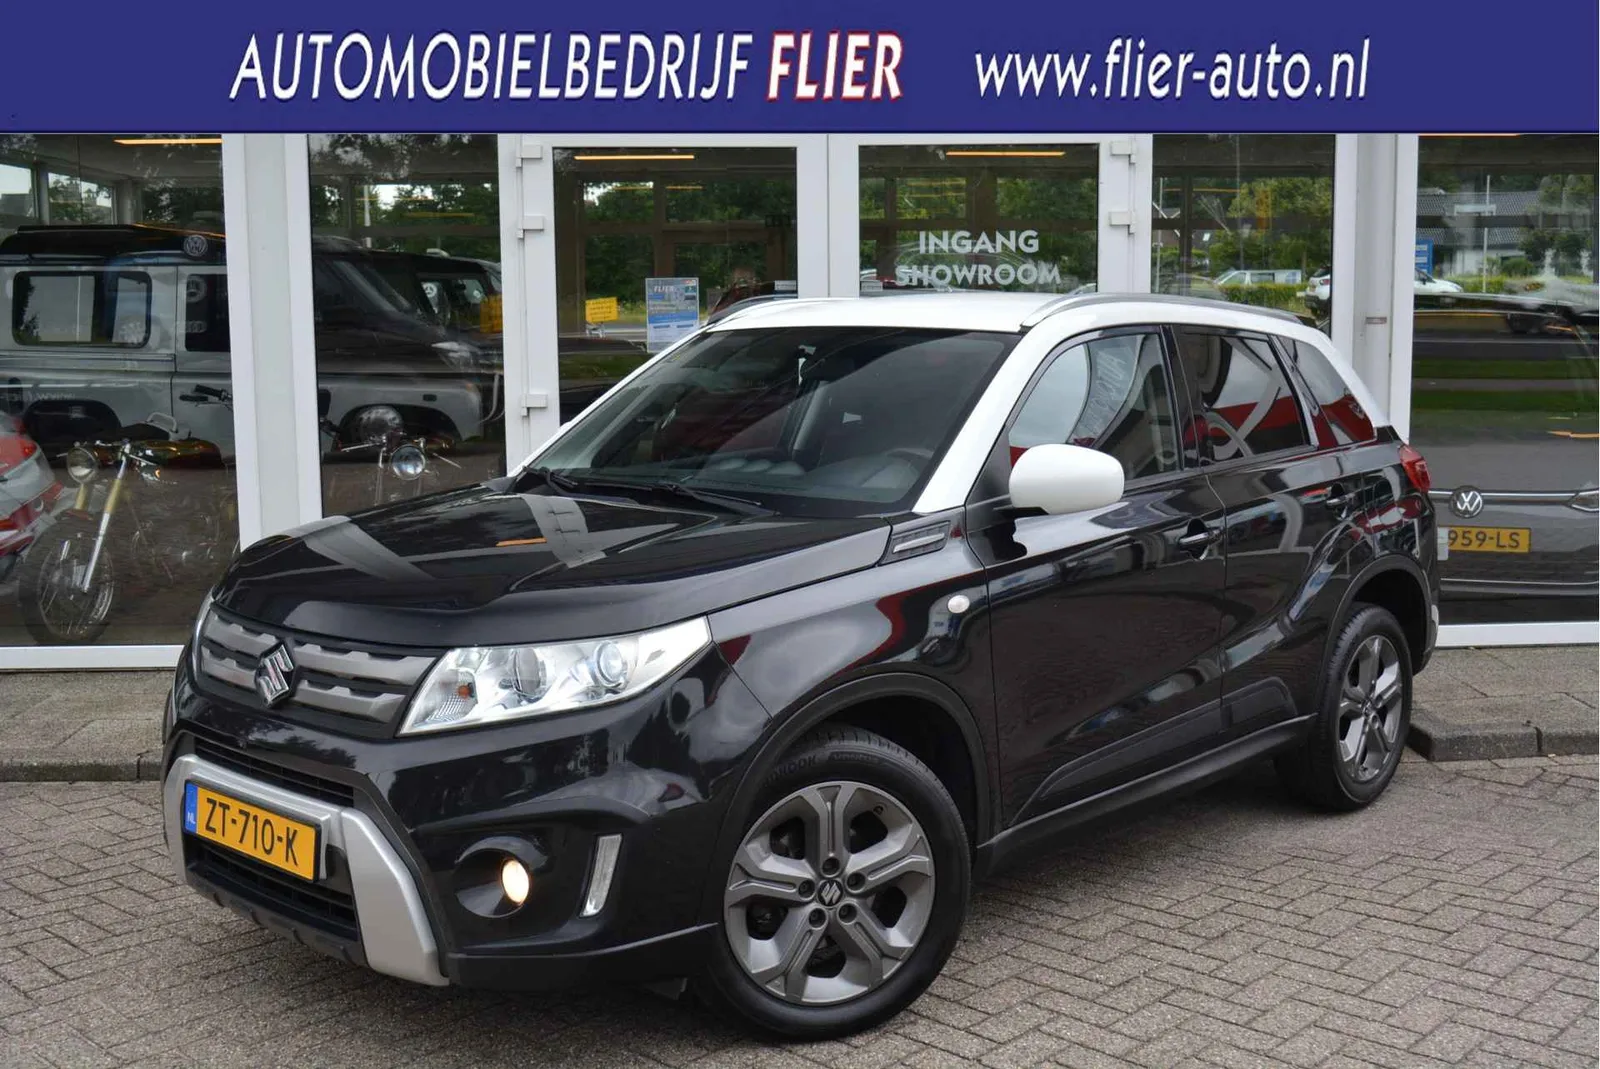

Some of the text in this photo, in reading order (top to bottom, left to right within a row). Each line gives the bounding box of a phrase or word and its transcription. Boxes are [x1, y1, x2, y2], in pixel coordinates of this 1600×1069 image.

[919, 230, 1039, 254] INGANG
[895, 262, 1061, 286] SHOWROOM
[205, 797, 298, 866] ZT-710-K
